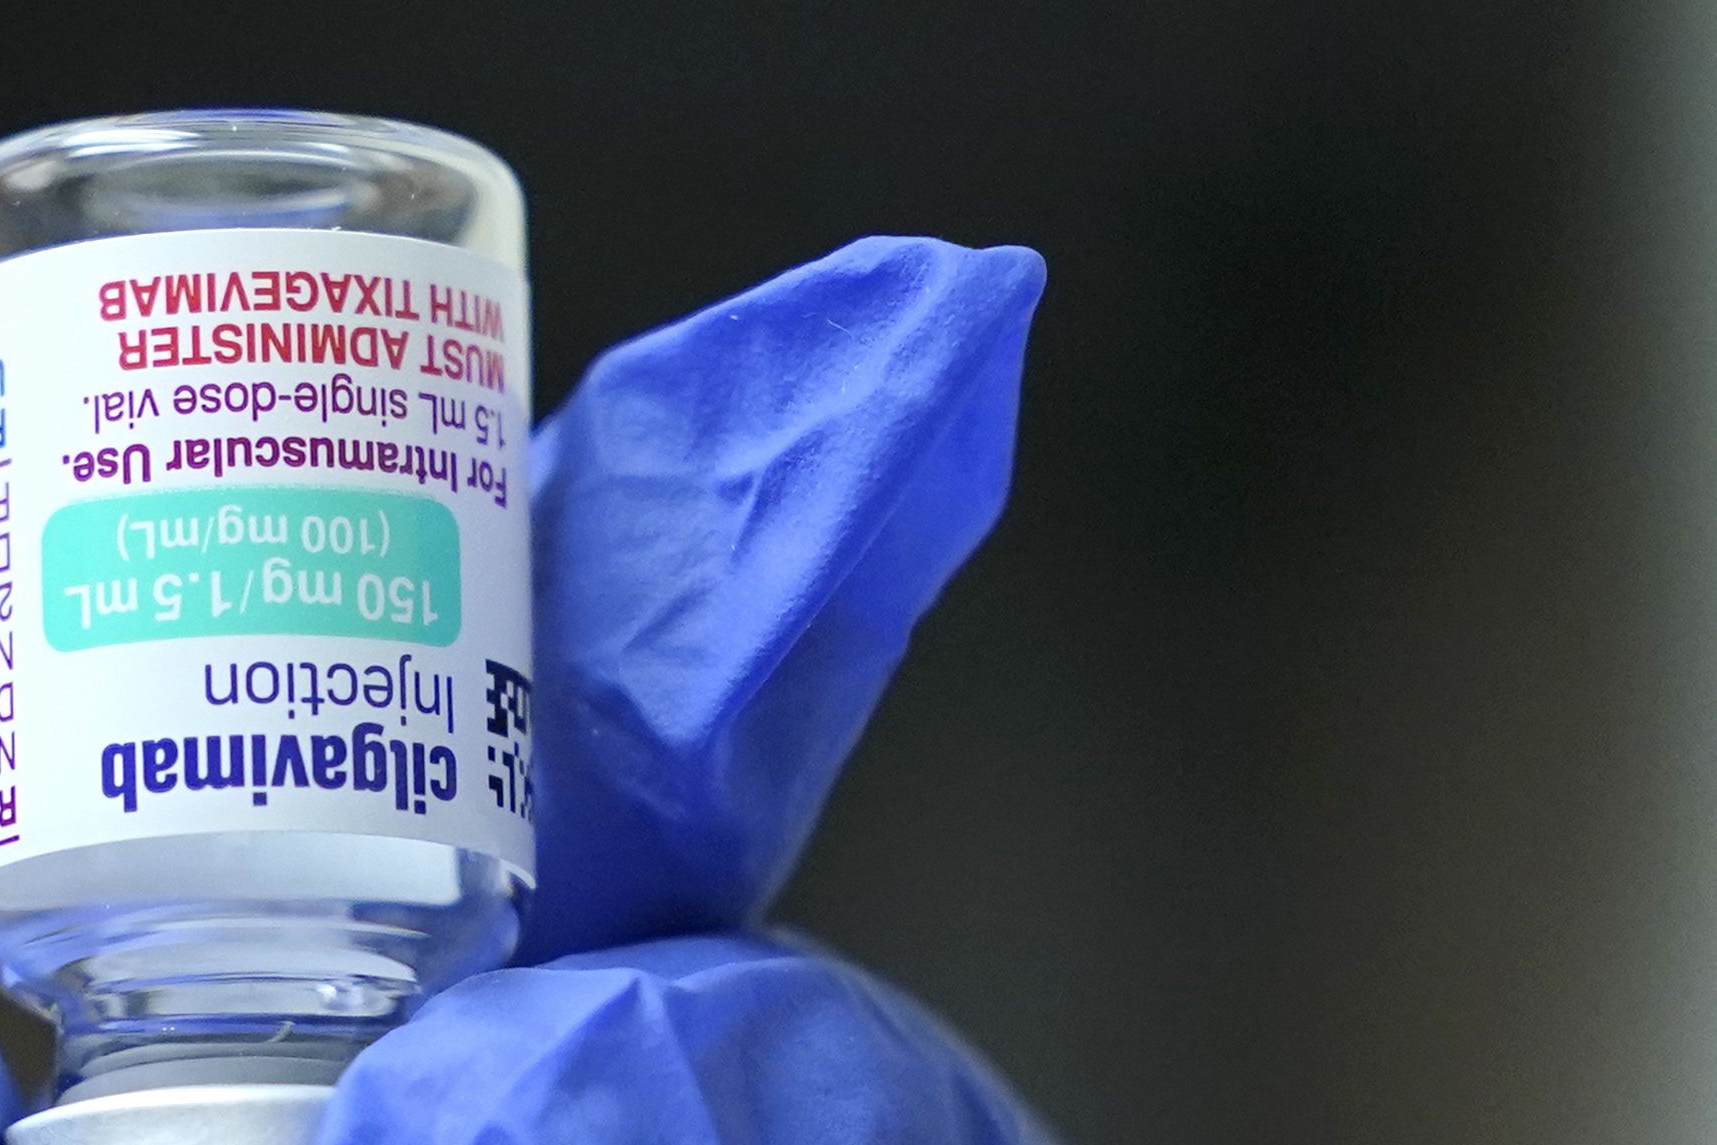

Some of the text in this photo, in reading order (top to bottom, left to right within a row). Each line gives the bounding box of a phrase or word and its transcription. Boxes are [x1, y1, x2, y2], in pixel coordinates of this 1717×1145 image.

[98, 270, 504, 343] WITH TIXAGEVIMAB
[118, 322, 504, 393] MUST ADMINISTER
[82, 374, 506, 450] 1.5 mL single-dose vial.
[62, 437, 508, 508] For Intramuscular Use.
[116, 505, 390, 562] (100 mg/mL)
[64, 578, 138, 628] mL
[357, 574, 438, 626] 150
[204, 655, 455, 734] Injection
[101, 722, 458, 814] cilgavimab
